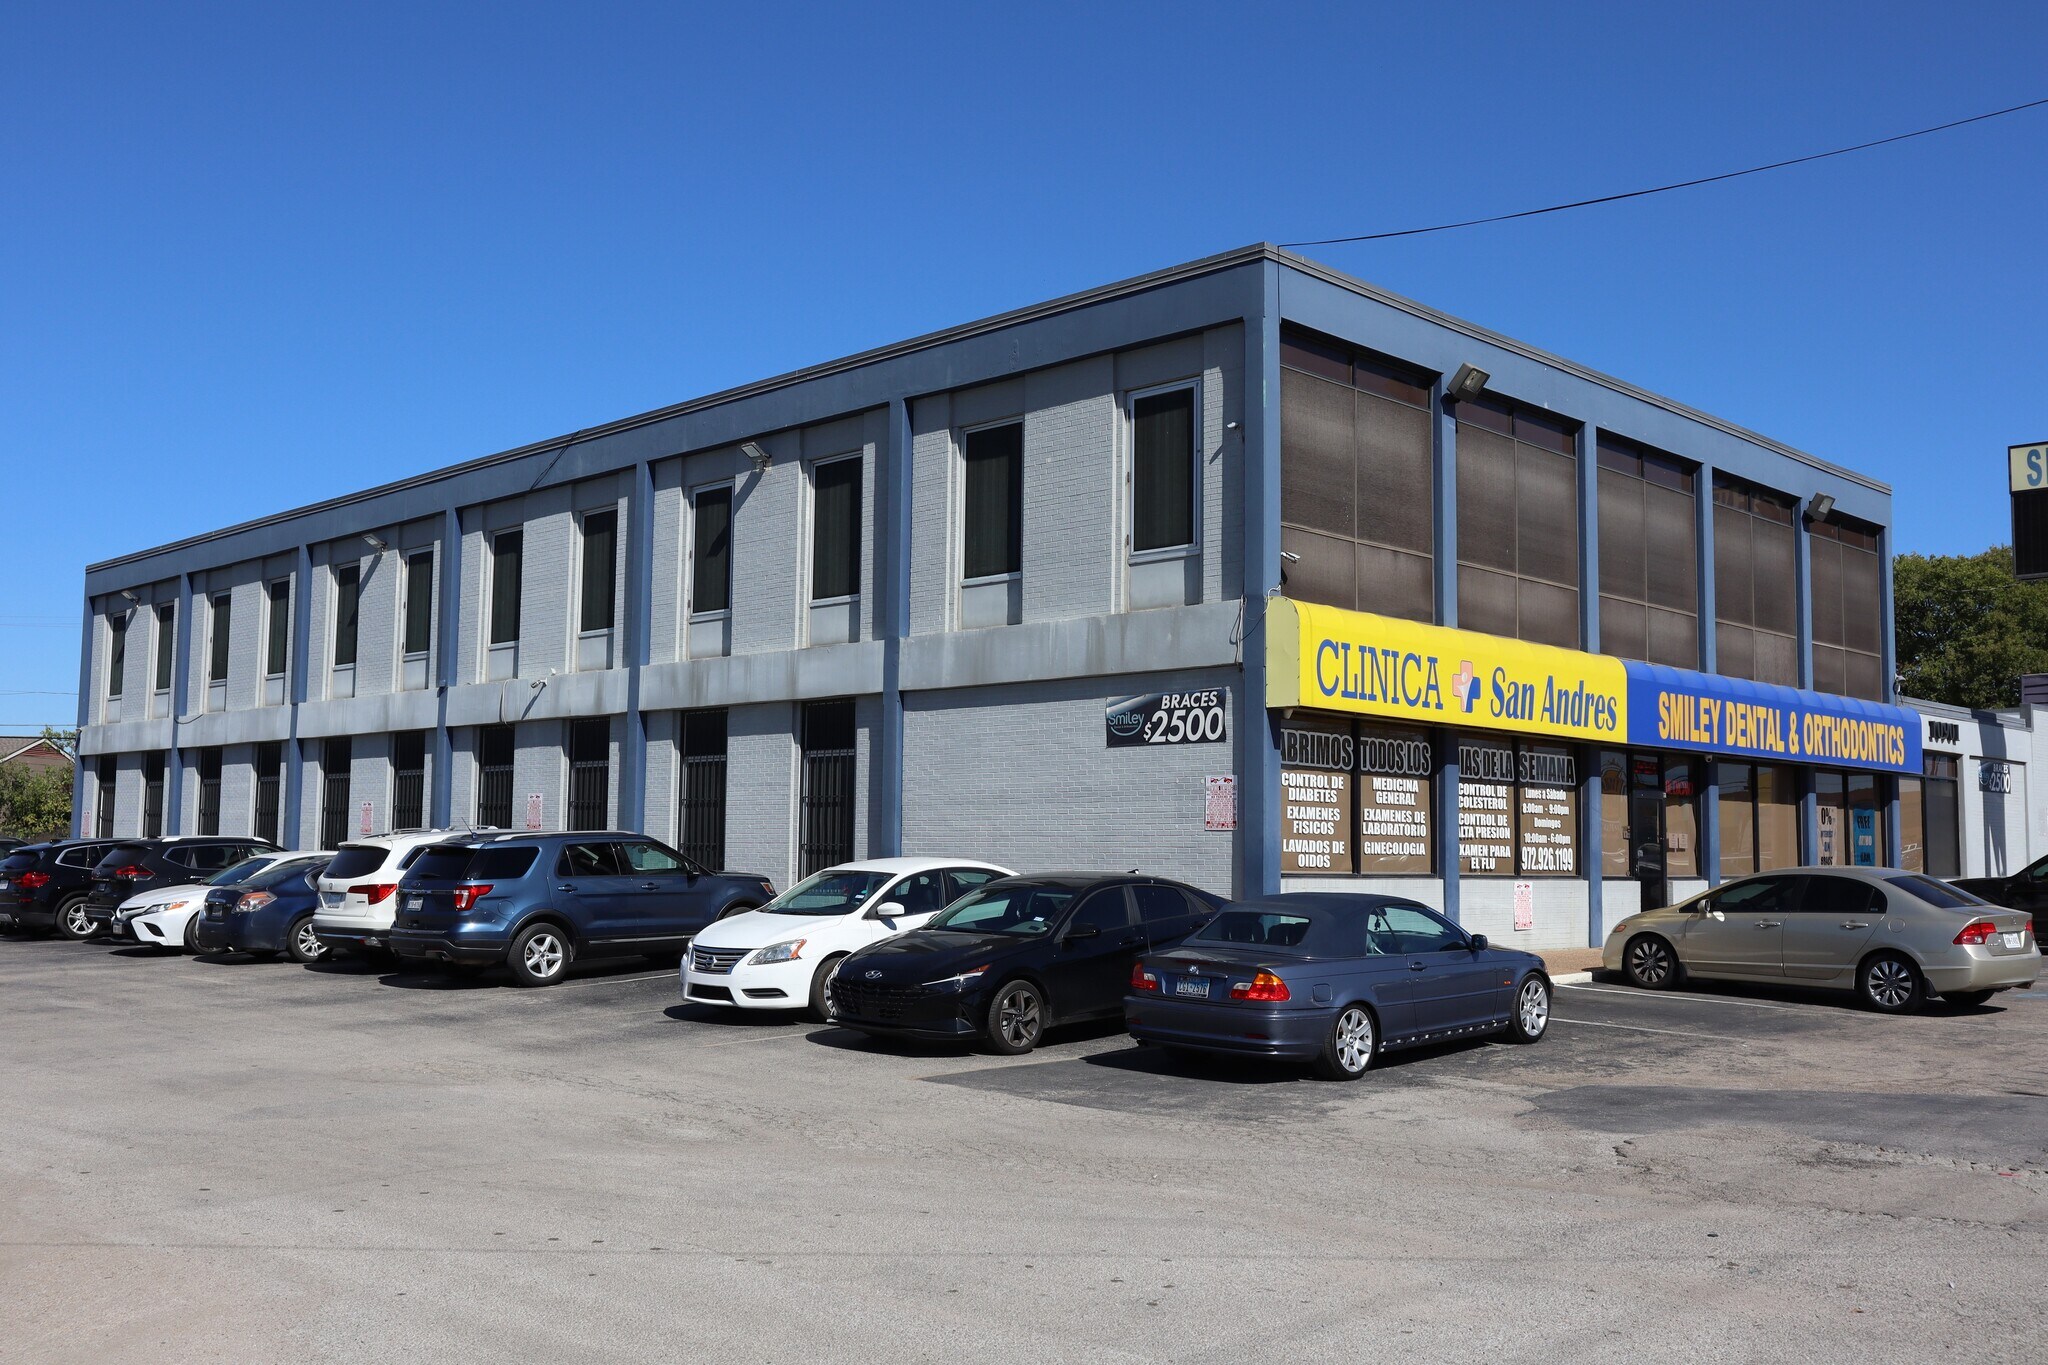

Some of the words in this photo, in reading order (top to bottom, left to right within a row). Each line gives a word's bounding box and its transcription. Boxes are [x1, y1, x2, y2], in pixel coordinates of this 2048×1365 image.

[1317, 639, 1443, 710] CLINICA
[1491, 667, 1535, 721] San
[1540, 675, 1617, 731] Andres
[1161, 691, 1218, 709] BRACES
[1108, 712, 1144, 726] Smiley
[1143, 707, 1224, 743] $2500
[1658, 691, 1721, 744] SMILEY
[1726, 701, 1785, 752] DENTAL
[1788, 711, 1799, 755] &
[1803, 713, 1905, 766] ORTHODONTICS
[1281, 729, 1353, 771] ABRIMOS
[1361, 737, 1405, 773] TODOS
[1405, 741, 1431, 775] LOS
[1459, 746, 1481, 779] IAS
[1481, 748, 1499, 780] DE
[1499, 750, 1514, 781] LA
[1519, 751, 1576, 785] SEMANA
[1281, 772, 1329, 789] CONTROL
[1331, 776, 1344, 789] DE
[1372, 777, 1419, 792] MEDICINA
[1288, 787, 1337, 803] DIABETES
[1458, 783, 1496, 797] CONTROL
[1497, 785, 1507, 797] DE
[1525, 787, 1541, 799] Lunes
[1375, 791, 1416, 806] GENERAL
[1458, 796, 1508, 810] COLESTEROL
[1287, 805, 1340, 821] EXAMENES
[1363, 808, 1412, 823] EXAMENES
[1414, 811, 1426, 824] DE
[1522, 802, 1543, 814] 8:00am
[1549, 803, 1569, 815] 9:00pm
[1821, 807, 1832, 825] 0%
[1458, 813, 1496, 826] CONTROL
[1497, 815, 1508, 827] DE
[1534, 817, 1561, 829] Domingos
[1293, 821, 1334, 835] FISICOS
[1362, 822, 1427, 837] LABORATORIO
[1475, 826, 1511, 839] PRESION
[1524, 832, 1548, 844] 10:00am
[1282, 839, 1330, 854] LAVADOS
[1332, 841, 1345, 854] DE
[1364, 841, 1426, 856] GINECOLOGIA
[1459, 843, 1489, 857] XAMEN
[1489, 844, 1511, 858] PARA
[1298, 853, 1331, 868] OIDOS
[1471, 857, 1480, 869] EL
[1481, 858, 1496, 870] FLU
[1521, 846, 1573, 872] 972.926.1199
